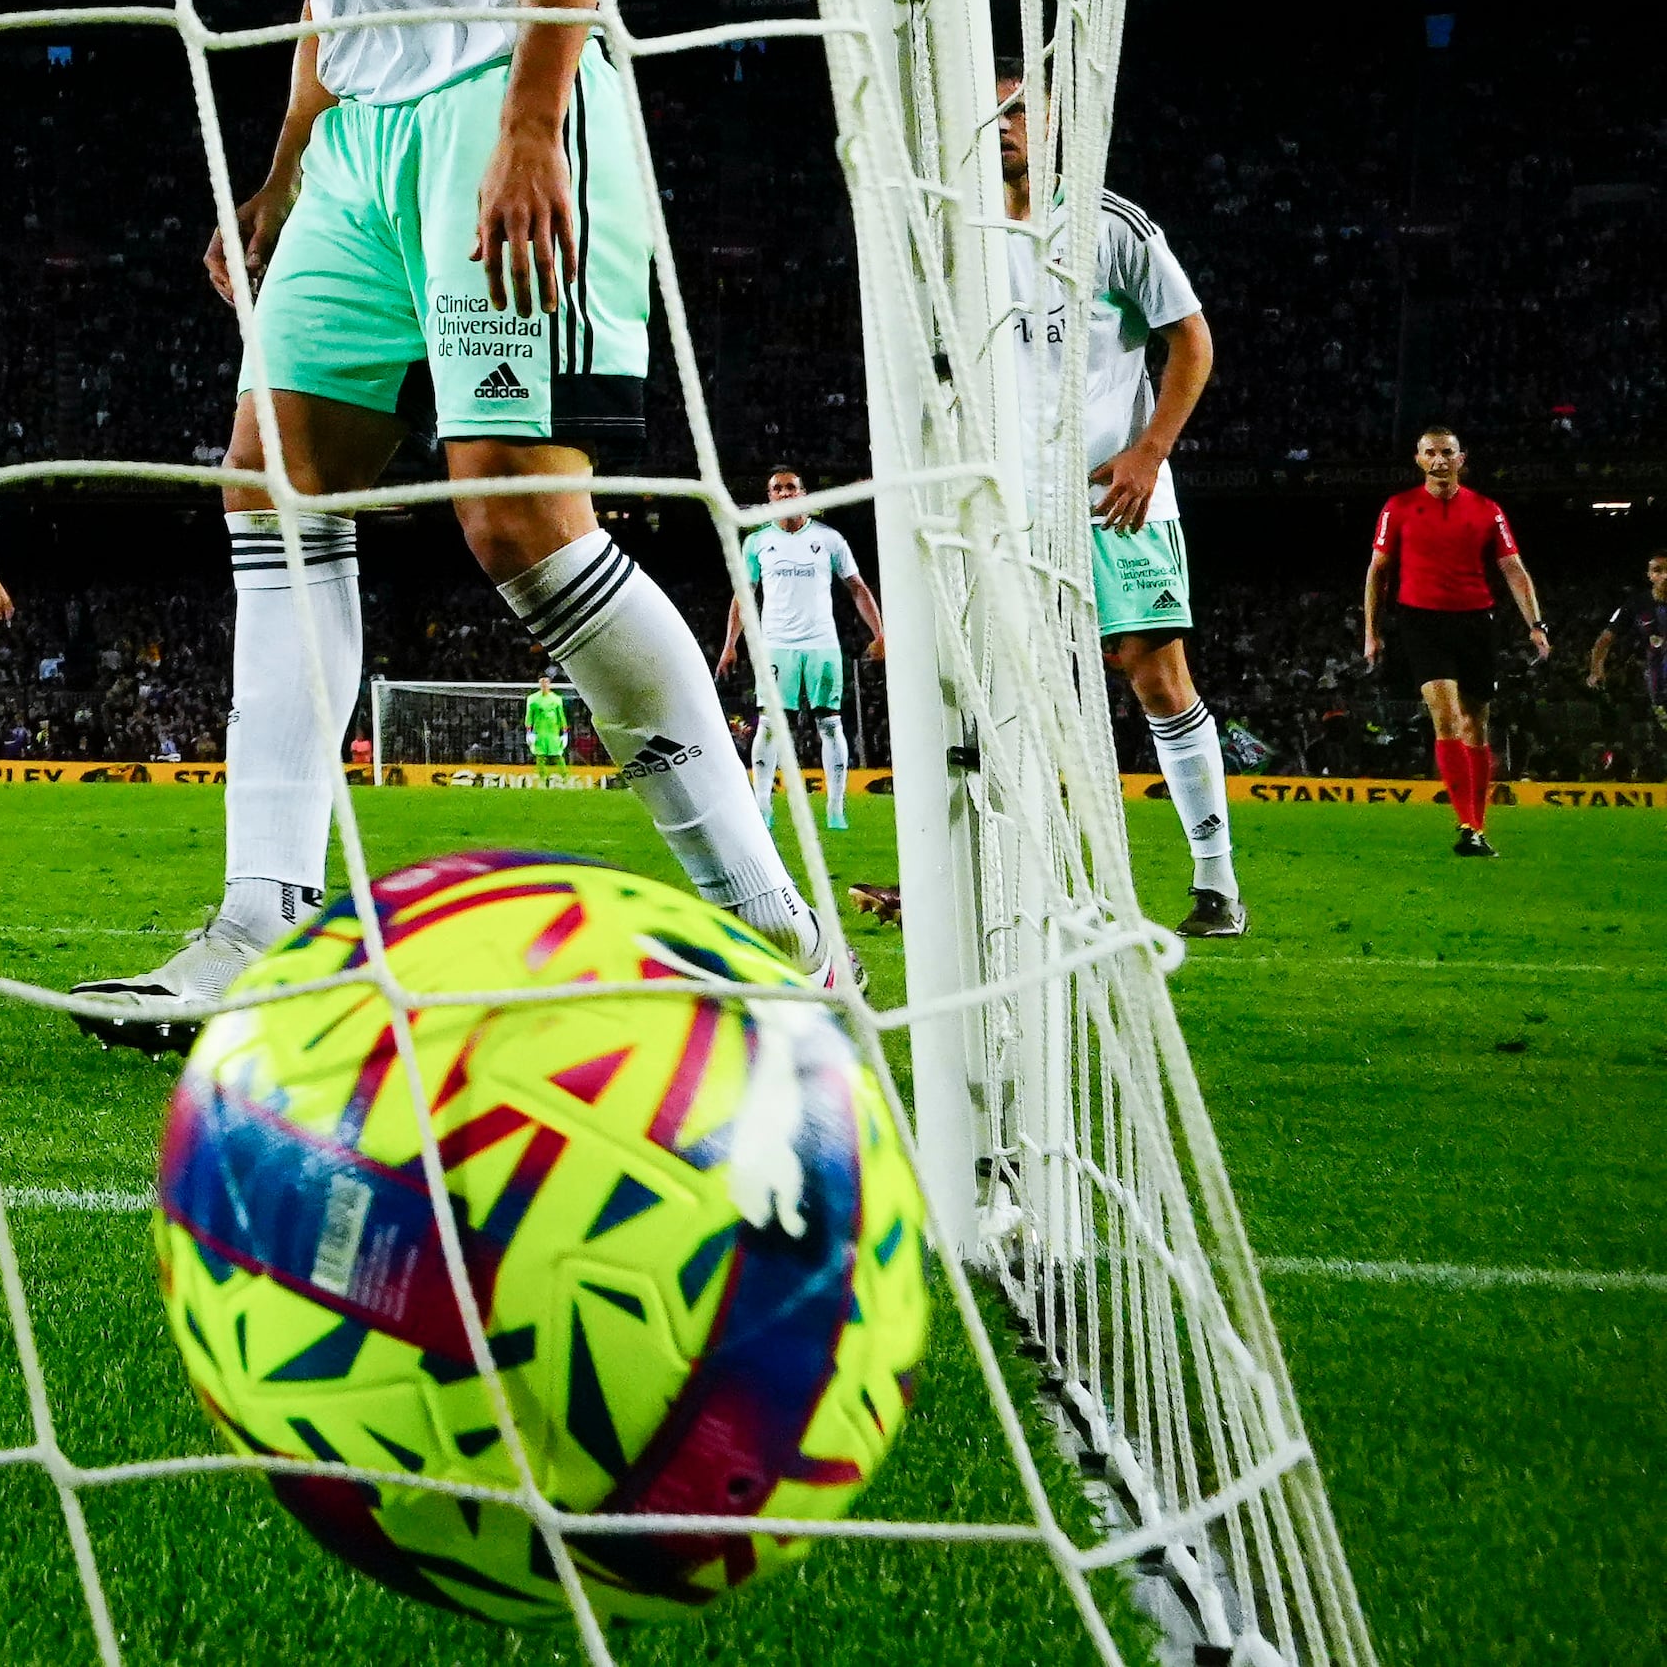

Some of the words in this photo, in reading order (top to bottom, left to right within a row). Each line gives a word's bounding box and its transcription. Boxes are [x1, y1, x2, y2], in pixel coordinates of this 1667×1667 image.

[438, 316, 542, 337] Universidad
[438, 338, 453, 357] de
[458, 337, 533, 358] Navarra
[474, 388, 529, 399] adidas
